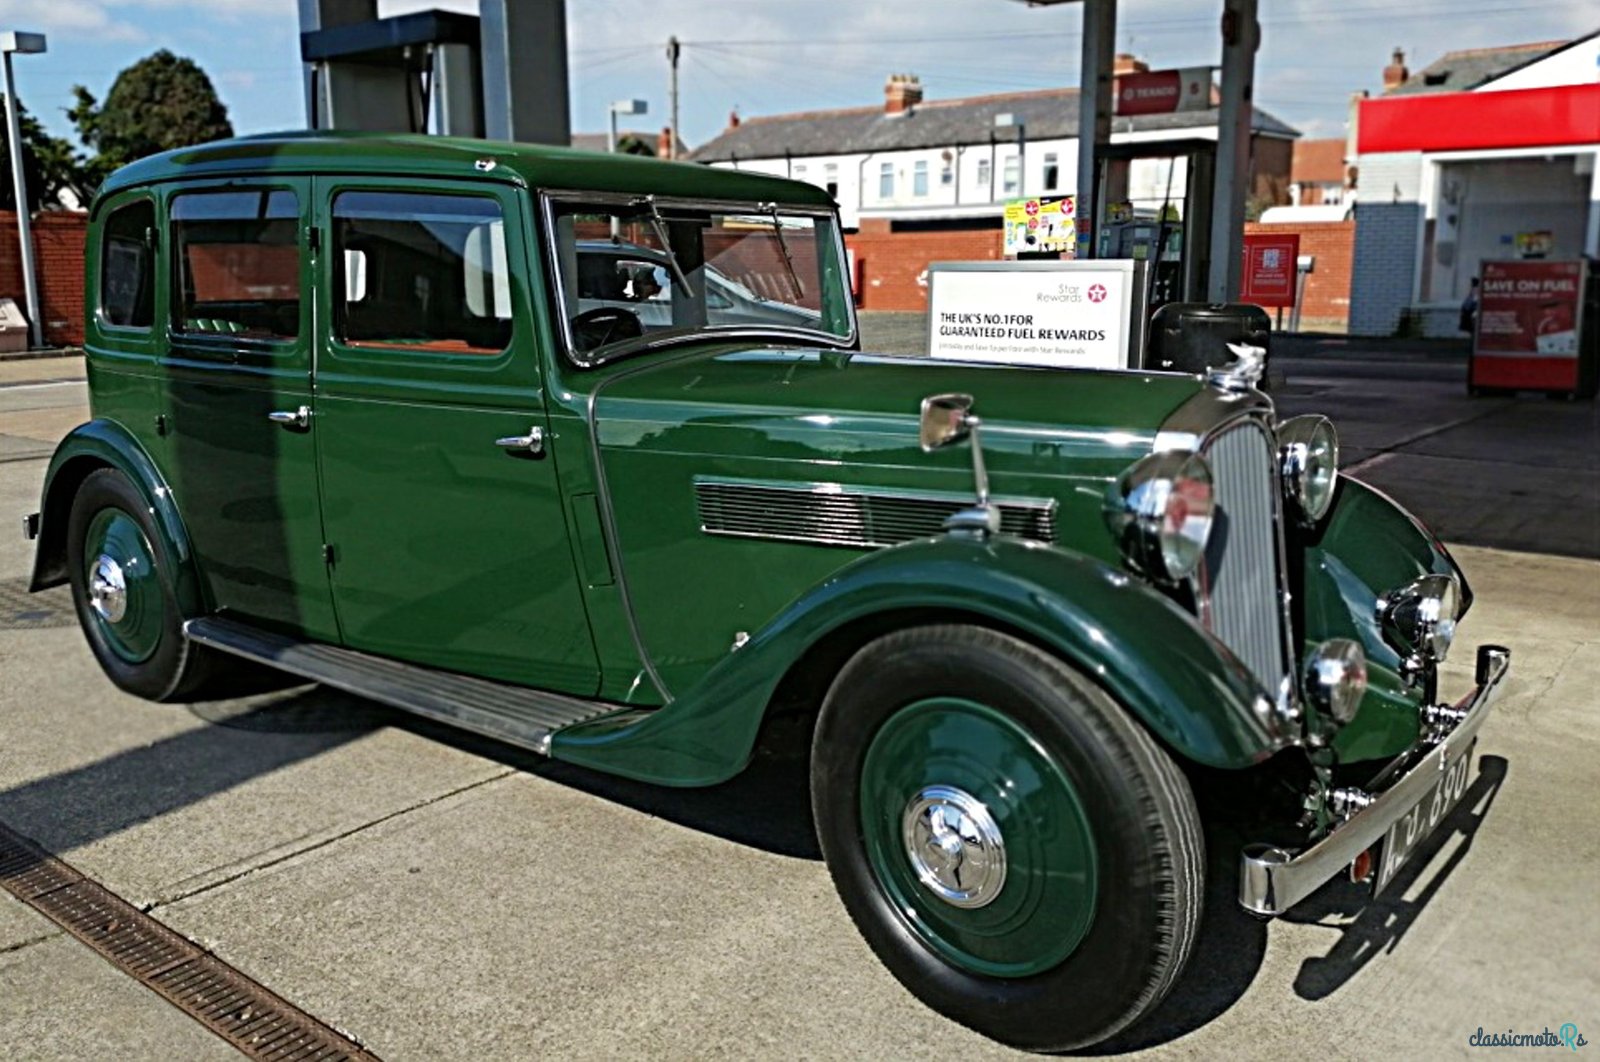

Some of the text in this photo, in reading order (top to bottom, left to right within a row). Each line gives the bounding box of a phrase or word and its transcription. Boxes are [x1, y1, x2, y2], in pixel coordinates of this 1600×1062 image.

[1058, 283, 1080, 295] Star
[1483, 279, 1575, 291] SAVE ON FUEL
[1036, 292, 1082, 303] Rewards
[940, 312, 956, 323] THE
[958, 313, 981, 324] UK'S
[939, 325, 1106, 342] GUARANTEED FUEL REWARDS
[1430, 753, 1468, 827] 690
